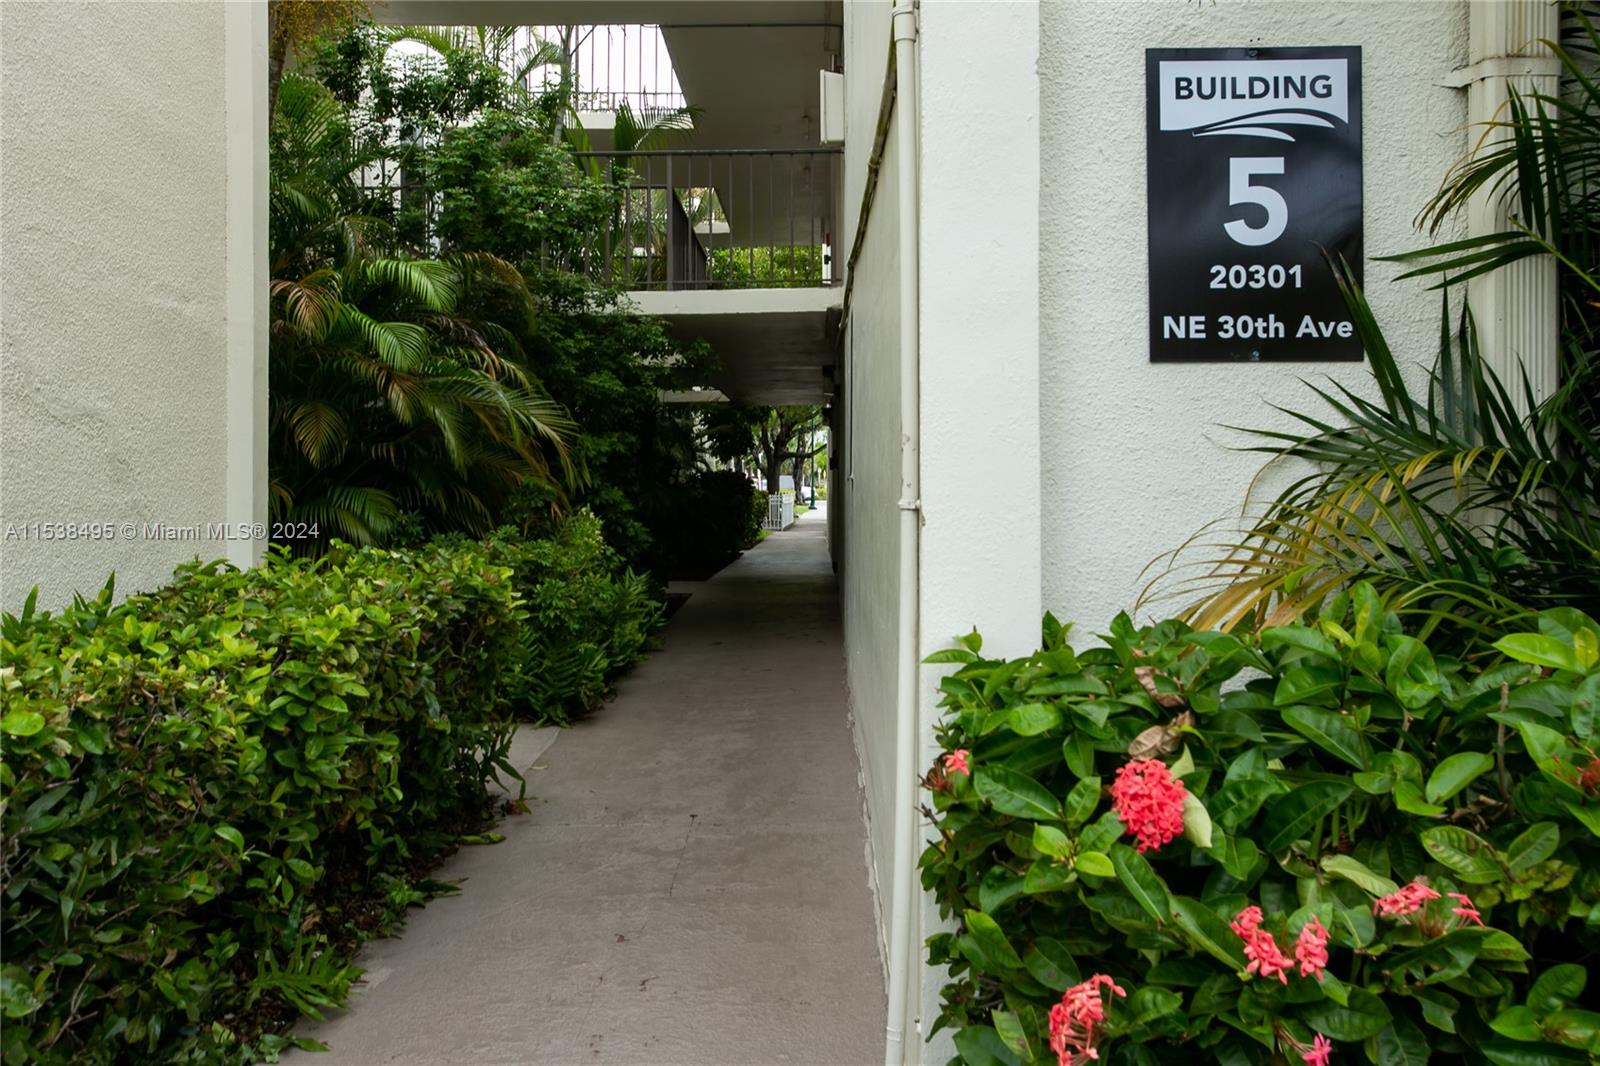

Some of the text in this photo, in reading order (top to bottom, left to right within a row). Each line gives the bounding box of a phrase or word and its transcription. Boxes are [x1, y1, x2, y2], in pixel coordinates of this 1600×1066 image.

[1174, 74, 1333, 100] BUILDING
[1223, 156, 1289, 247] 5
[1209, 264, 1302, 289] 20301
[1162, 314, 1353, 339] NE 30th Ave
